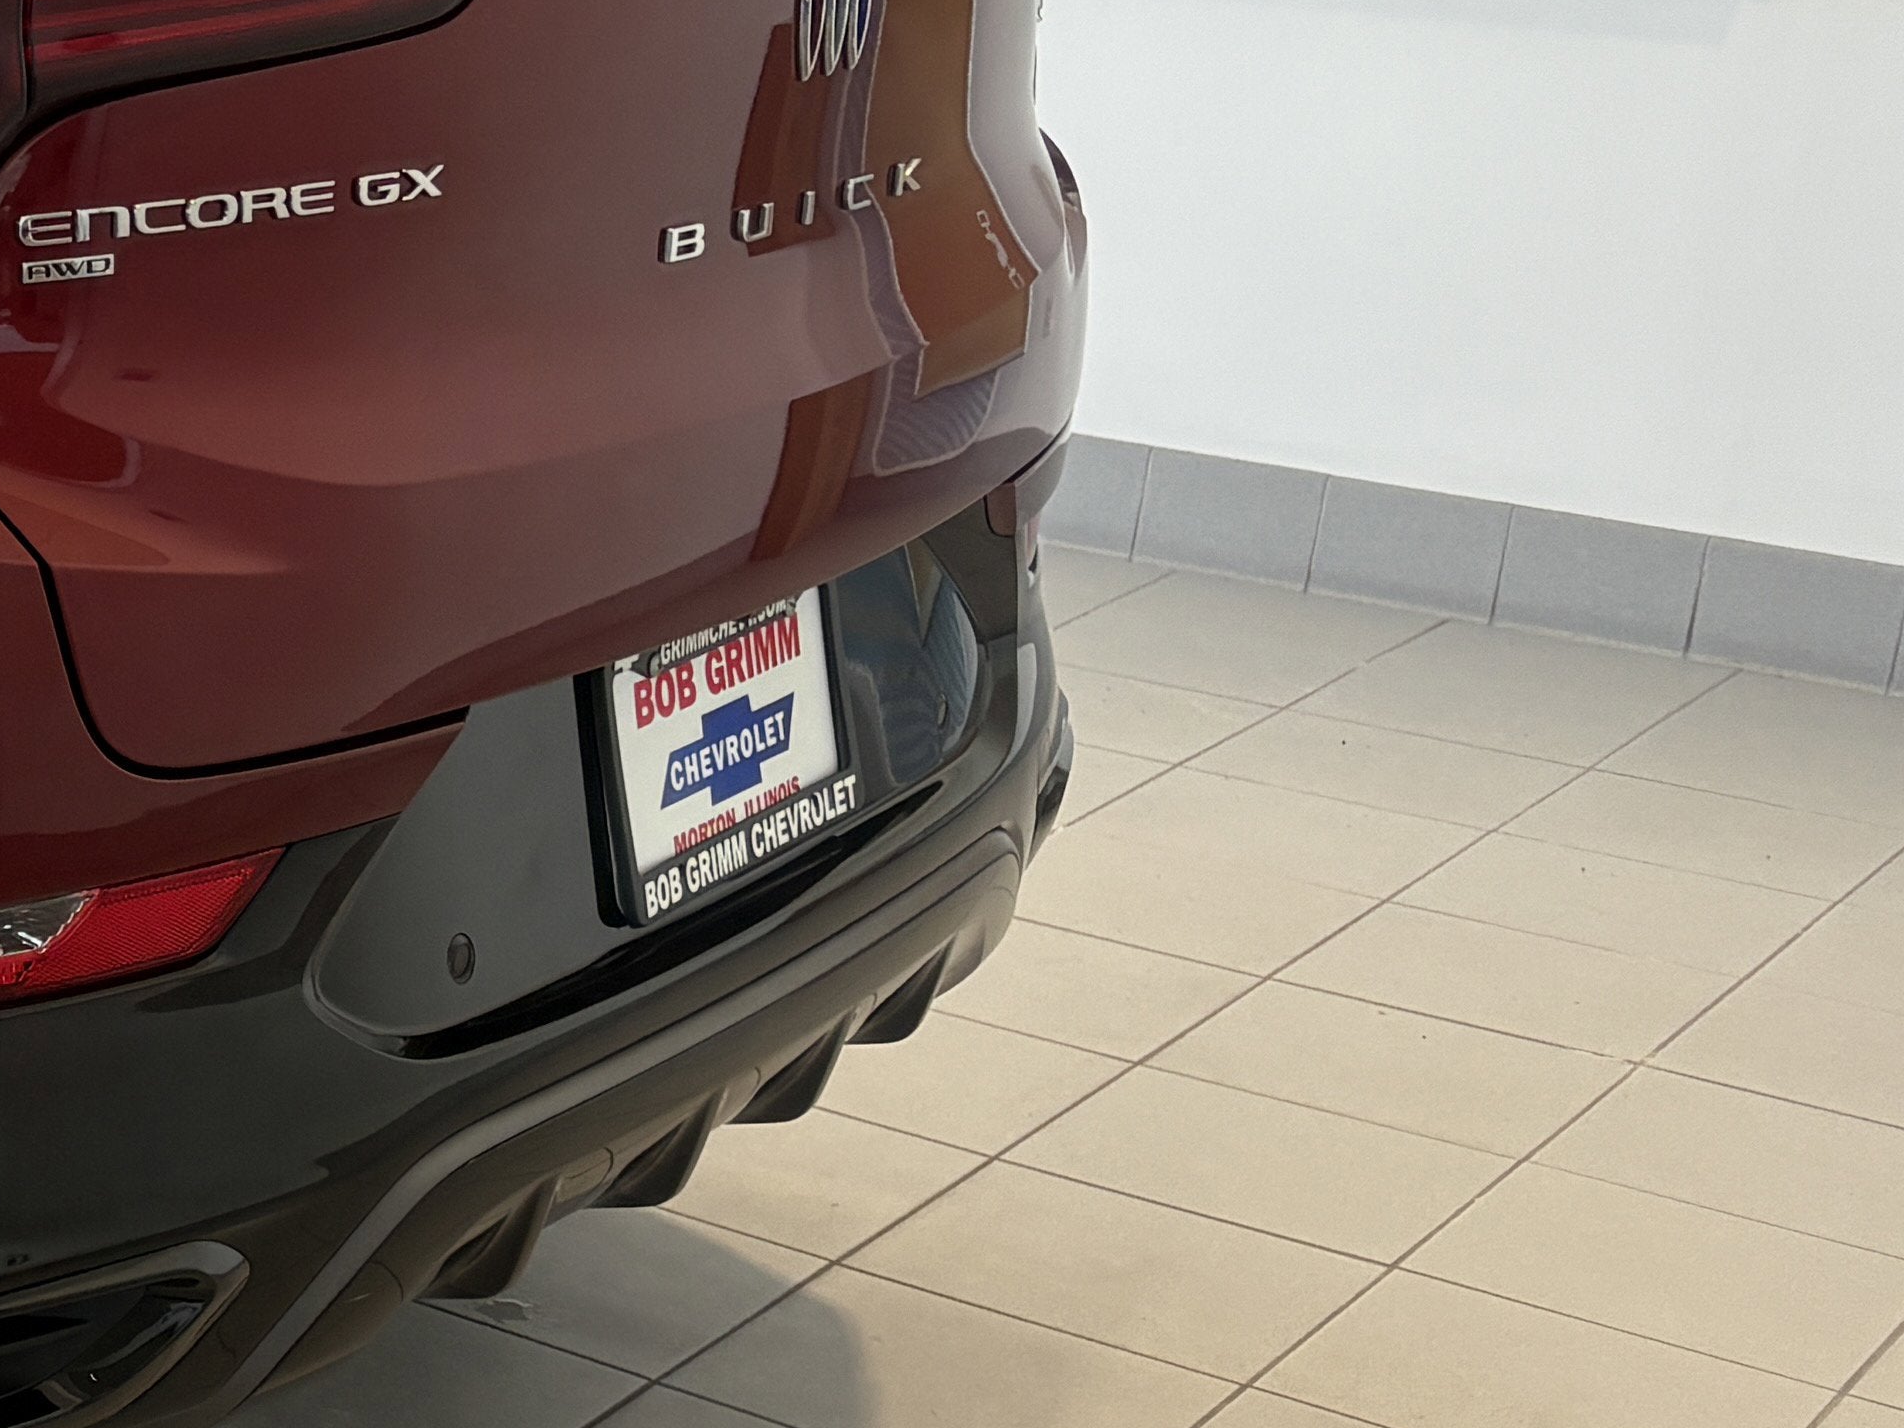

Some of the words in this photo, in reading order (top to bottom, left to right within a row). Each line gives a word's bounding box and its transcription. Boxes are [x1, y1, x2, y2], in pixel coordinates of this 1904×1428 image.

[18, 179, 336, 248] ENCORE
[356, 164, 445, 208] GX
[659, 157, 923, 264] BUICK
[24, 255, 114, 283] AWD
[633, 659, 697, 729] BOB
[704, 610, 801, 696] GRIMM
[669, 710, 785, 792] CHEVROLET
[743, 775, 801, 817] ILLINOIS
[644, 871, 683, 919] BOB
[685, 831, 748, 894] GRIMM
[751, 774, 857, 858] CHEVROLET
